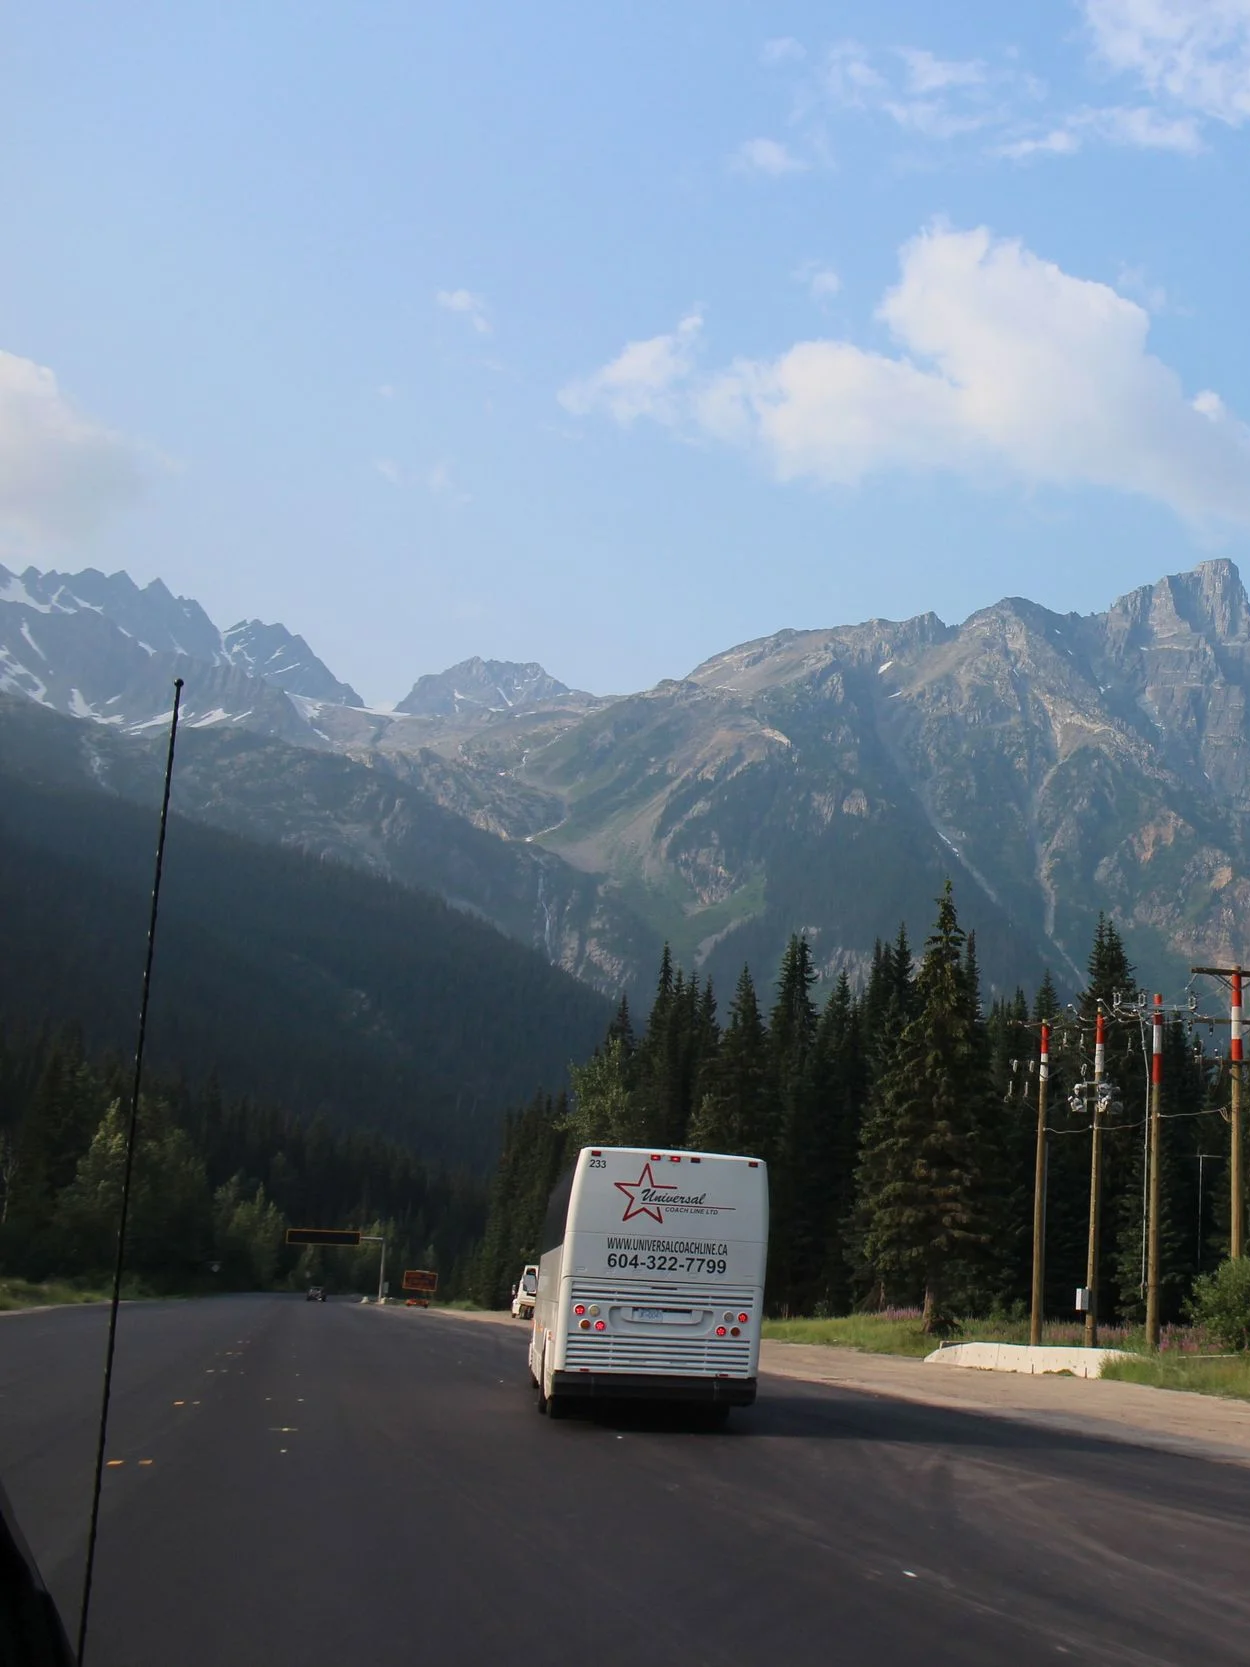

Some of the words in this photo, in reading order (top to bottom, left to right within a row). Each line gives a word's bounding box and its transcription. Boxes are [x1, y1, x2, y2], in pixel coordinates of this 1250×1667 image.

[589, 1159, 607, 1168] 233
[641, 1188, 706, 1205] Universal
[607, 1237, 728, 1256] WWW.UNIVERSALCOACHLINE.CA
[607, 1253, 727, 1273] 604-322-7799
